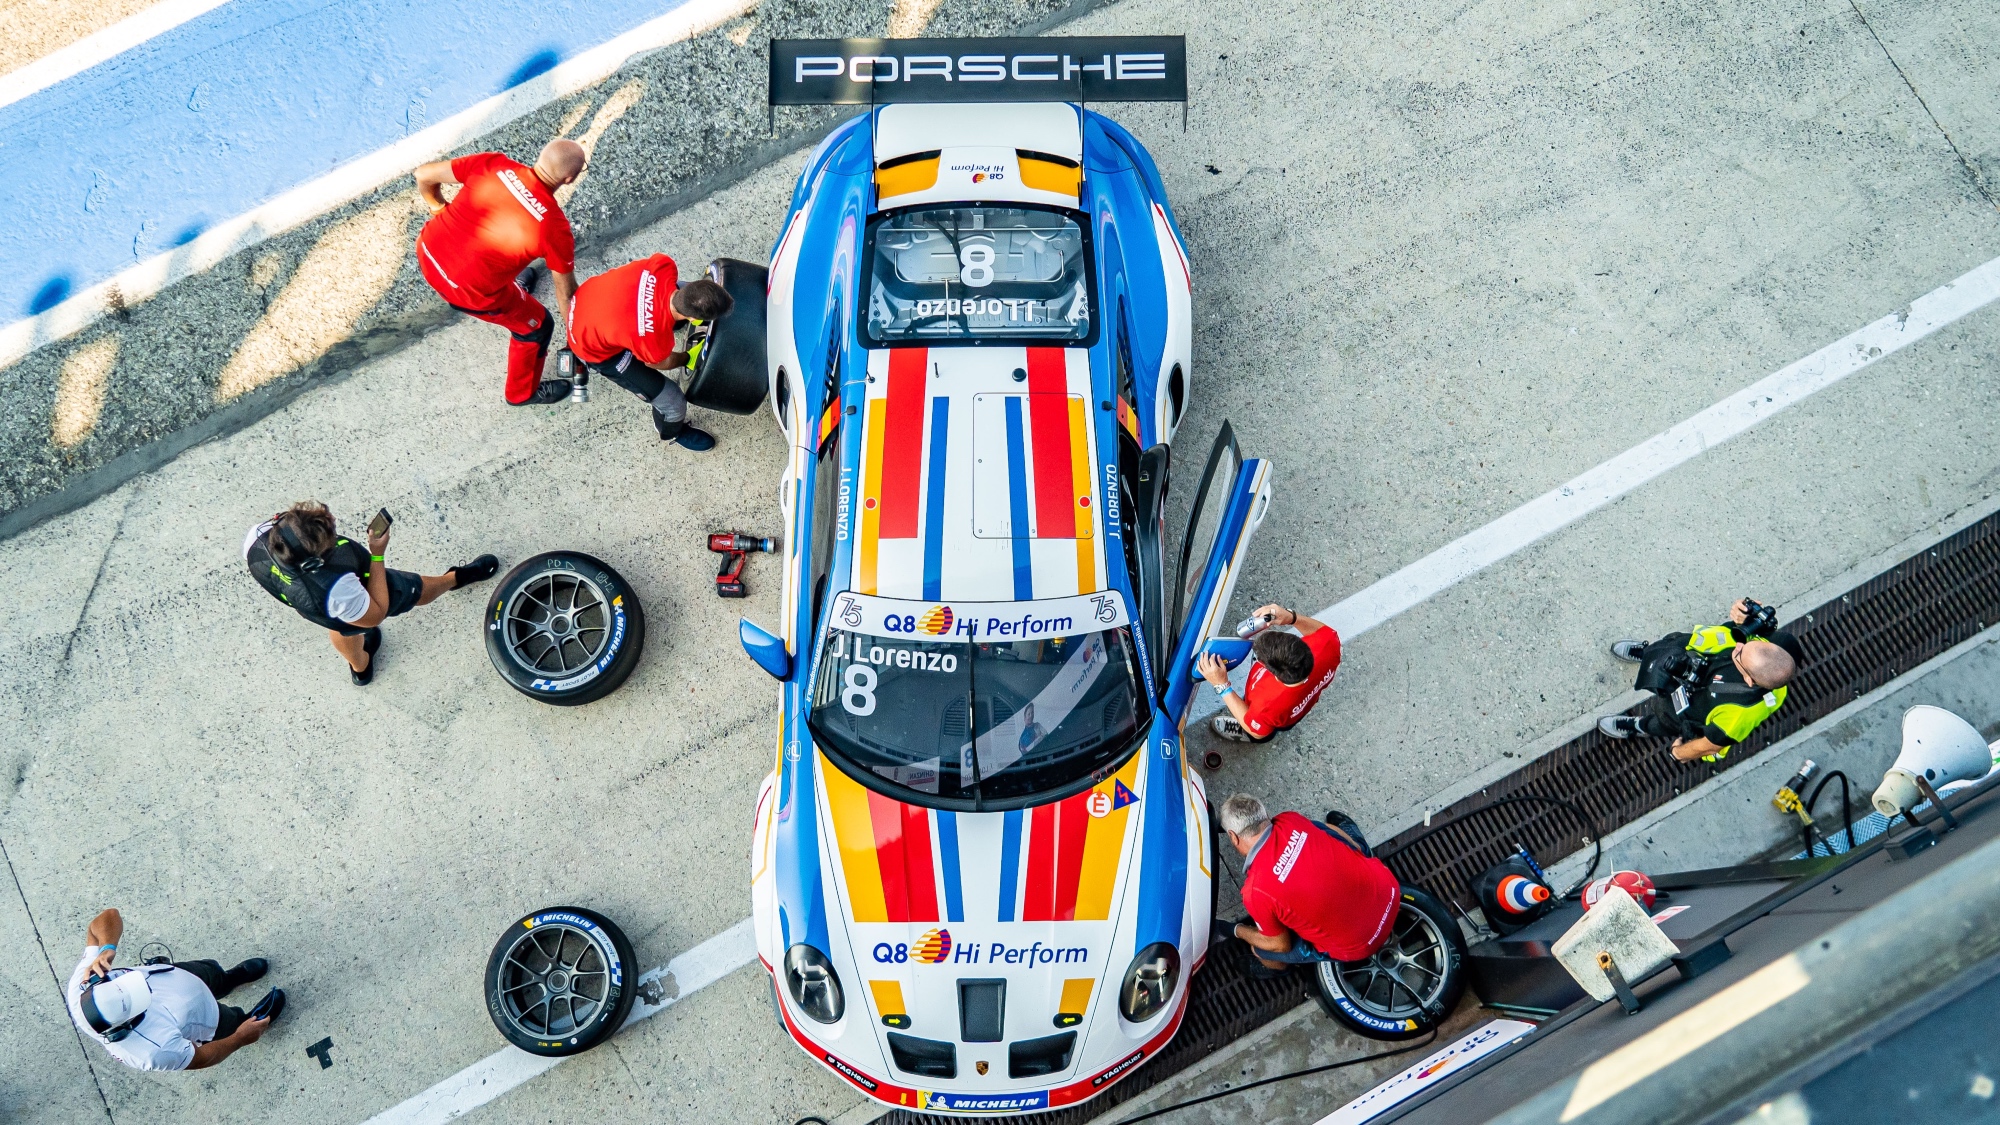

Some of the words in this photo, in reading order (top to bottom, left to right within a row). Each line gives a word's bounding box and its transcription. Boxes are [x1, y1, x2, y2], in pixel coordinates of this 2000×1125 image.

[795, 54, 1166, 82] PORSCHE
[951, 164, 990, 172] Perform
[504, 170, 547, 214] GHINZANI
[960, 245, 996, 287] 8
[644, 274, 656, 332] GHINZANI
[837, 478, 851, 540] LORENZO
[1106, 464, 1120, 526] LORENZO
[840, 596, 863, 627] 75
[884, 613, 916, 634] Q8
[956, 616, 978, 636] Hi
[986, 613, 1072, 638] Perform
[1090, 595, 1118, 624] 75
[600, 616, 624, 669] MICHELIN
[855, 638, 958, 673] Lorenzo
[1133, 620, 1154, 699] www.carreracupitalia.it
[842, 664, 878, 716] 8
[1292, 668, 1332, 714] GHINZANI
[1093, 797, 1105, 813] E
[1272, 829, 1301, 875] GHINZANI
[542, 914, 592, 928] MICHELIN
[872, 942, 908, 964] Q8
[954, 942, 980, 964] Hi
[989, 942, 1088, 968] Perform
[1340, 1000, 1394, 1030] MICHELIN
[1460, 1030, 1500, 1052] Q8
[954, 1098, 1040, 1108] MICHELIN
